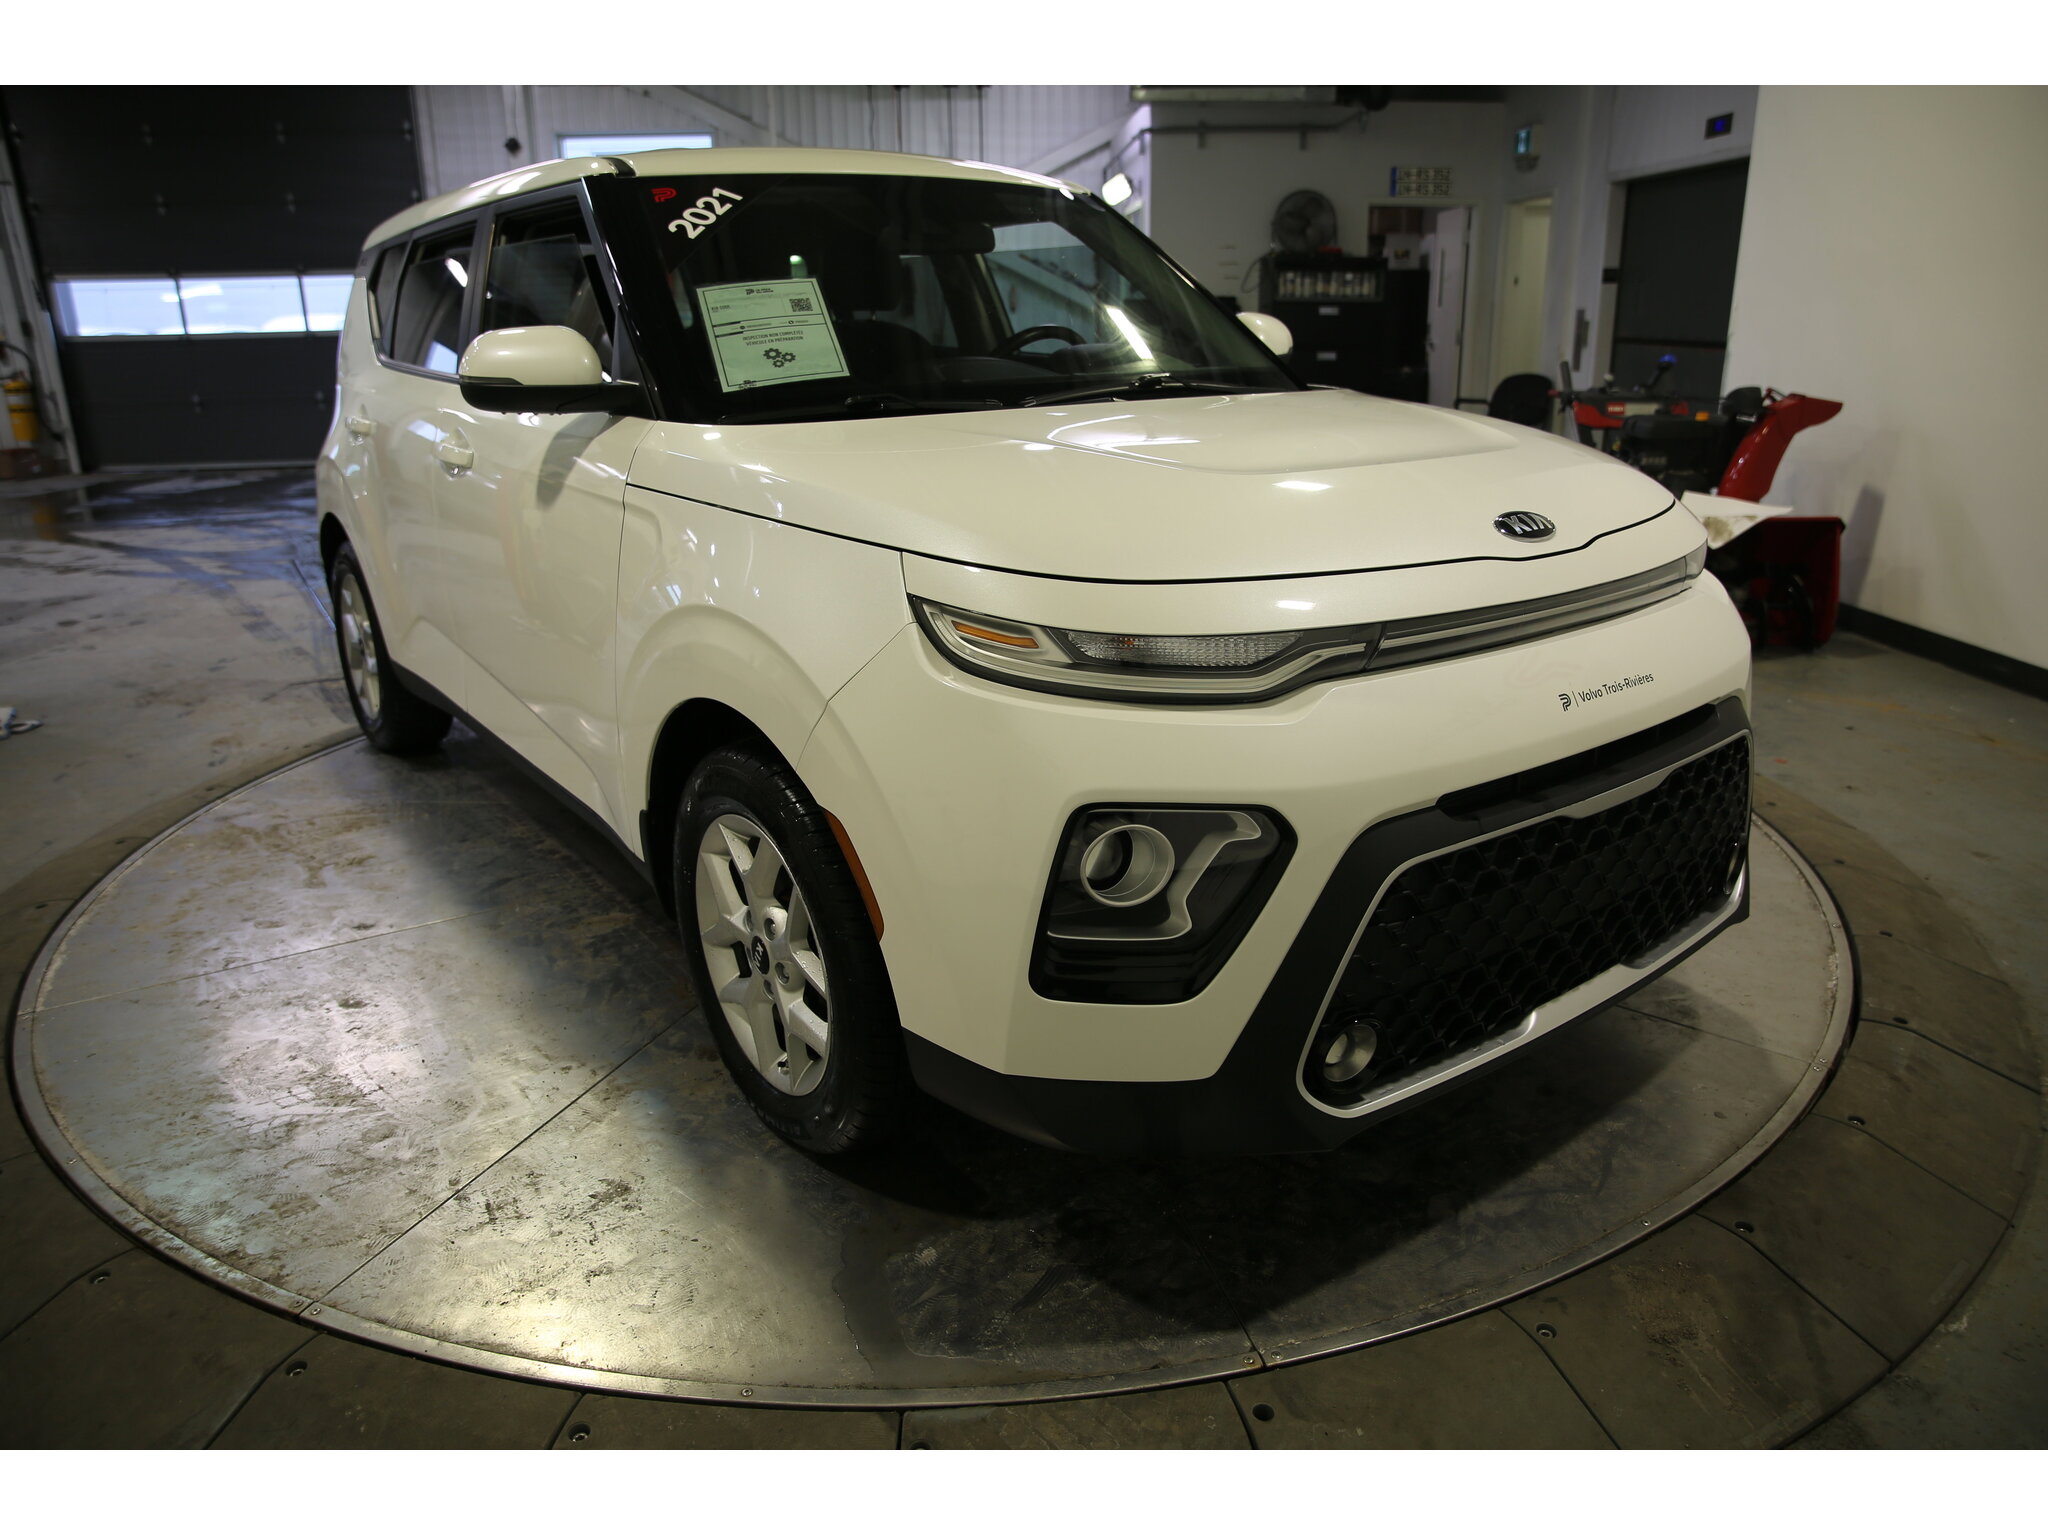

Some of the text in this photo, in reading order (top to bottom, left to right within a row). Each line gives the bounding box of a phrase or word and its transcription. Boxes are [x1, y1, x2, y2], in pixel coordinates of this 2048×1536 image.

[668, 187, 743, 239] 2021
[1502, 514, 1553, 534] KIA
[1578, 688, 1603, 702] Volvo
[1602, 673, 1654, 695] Trois-Rivières
[754, 942, 763, 968] KIA
